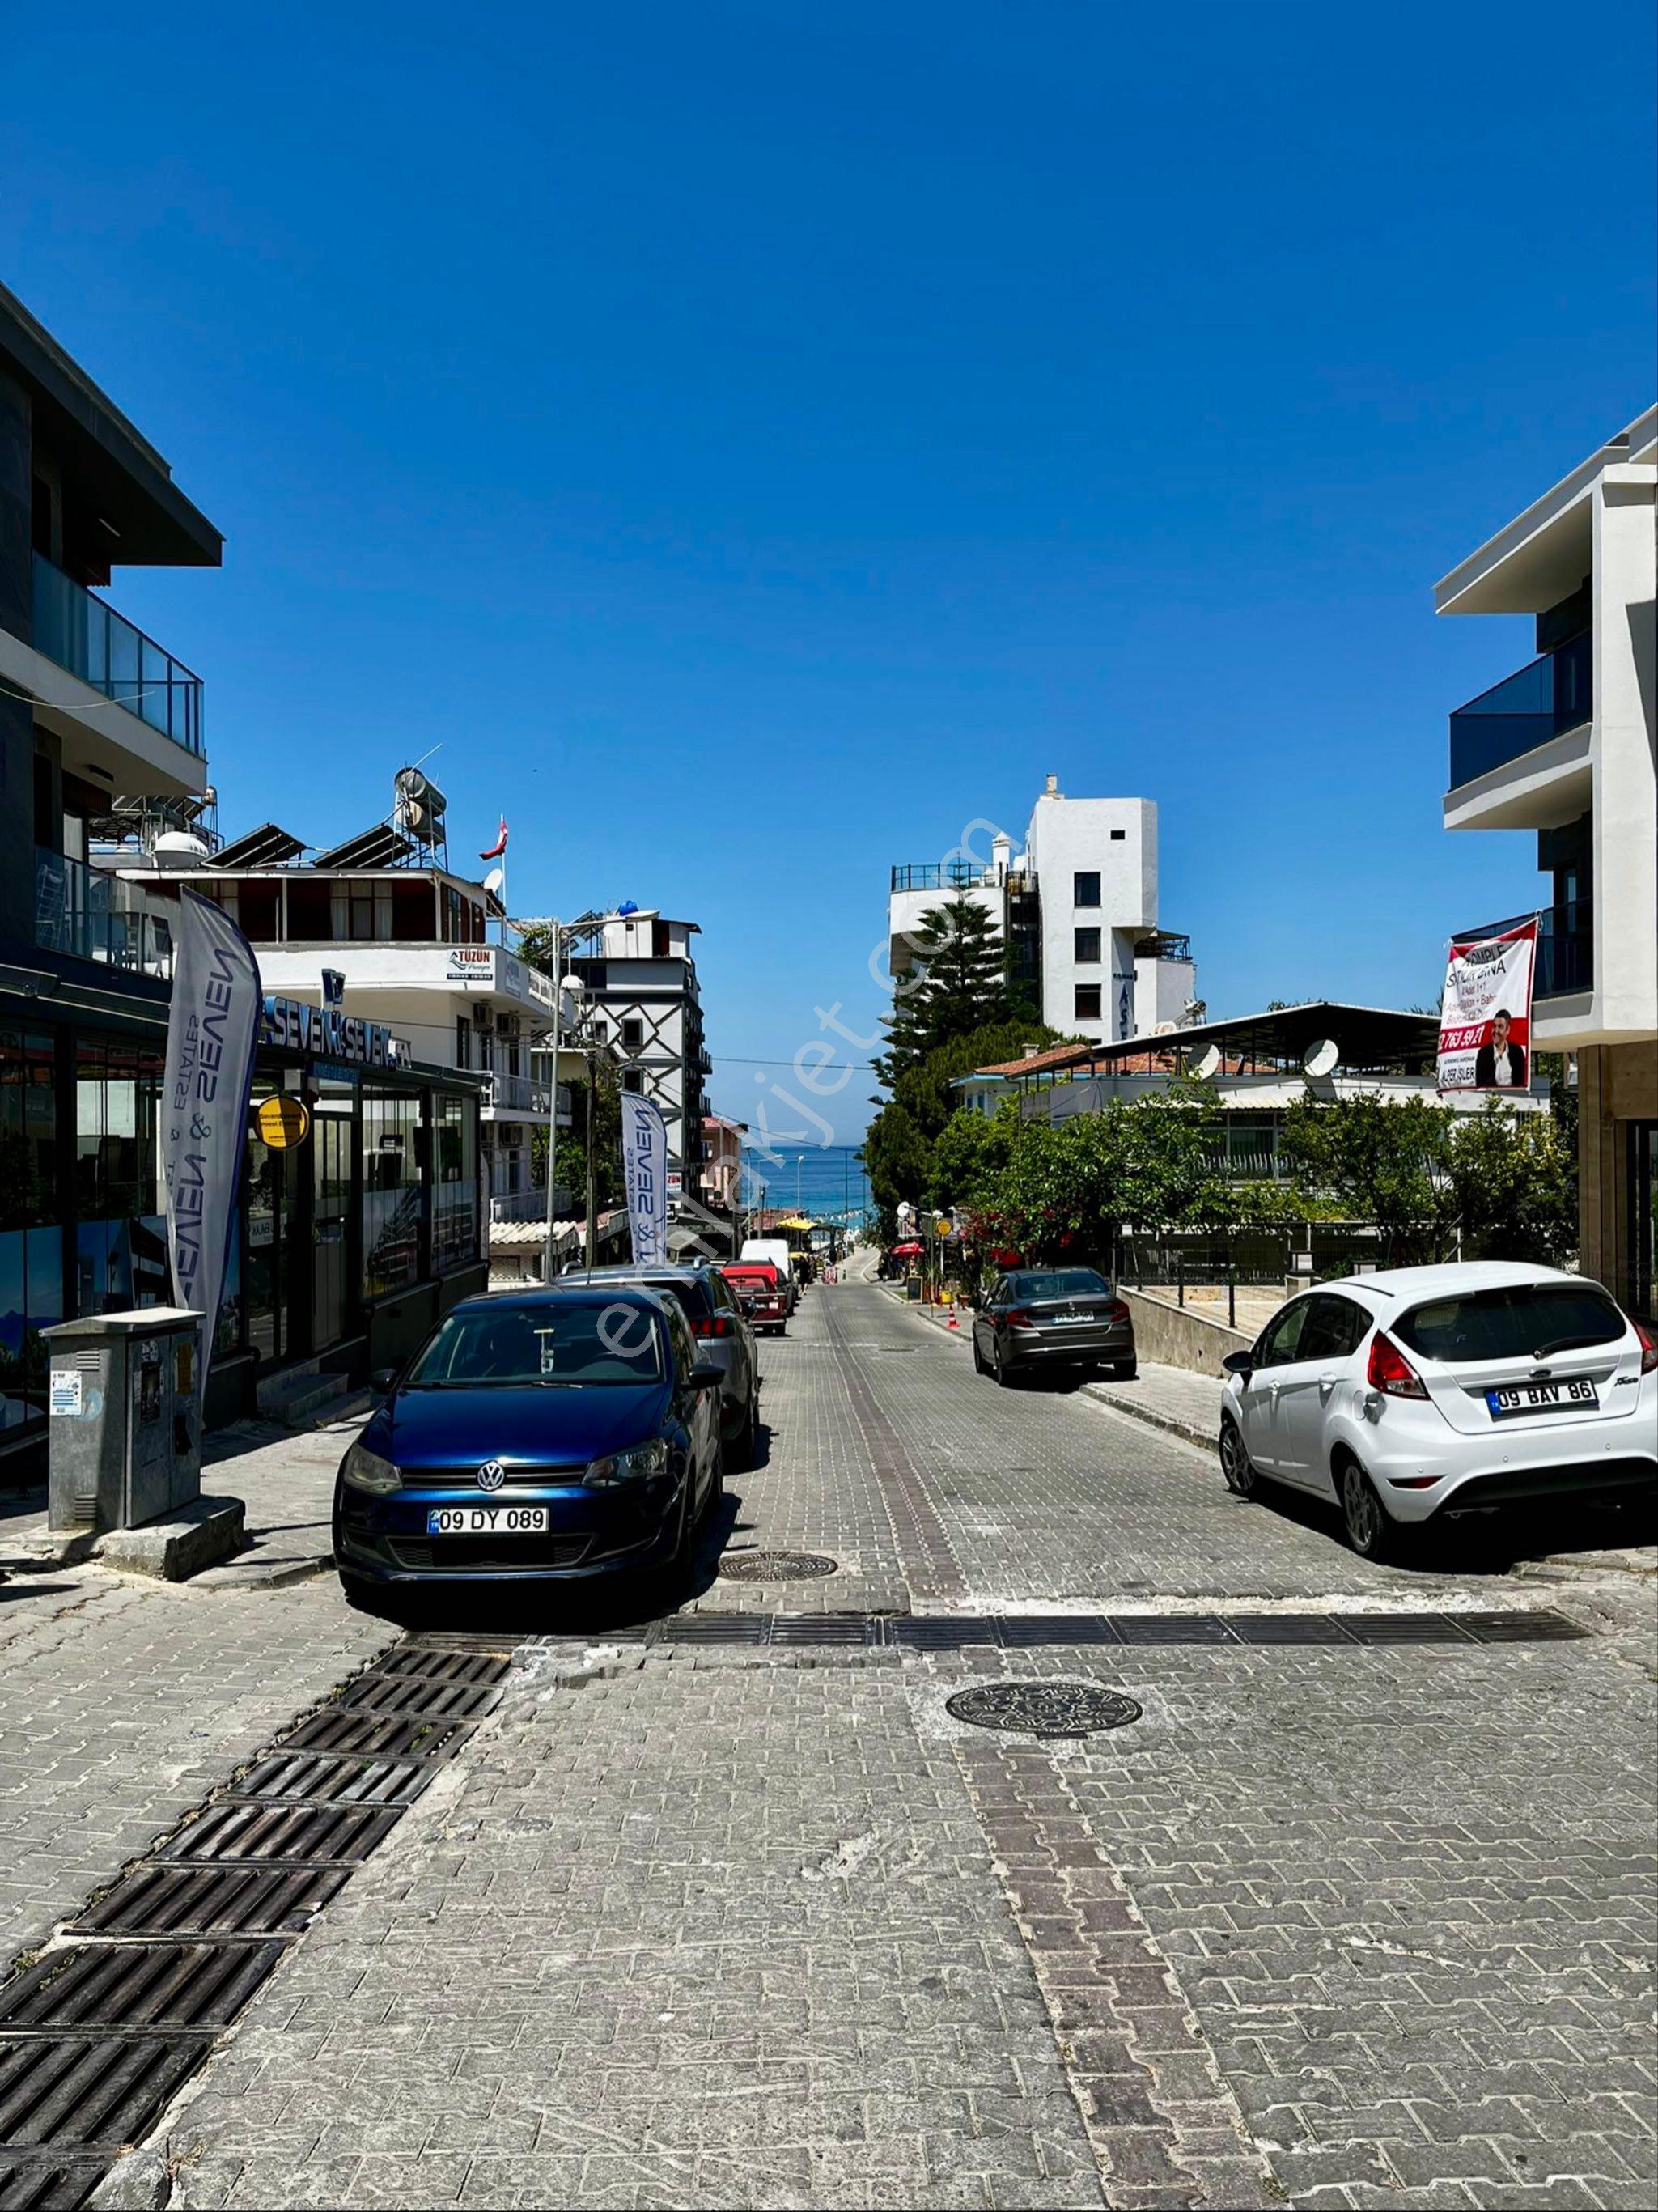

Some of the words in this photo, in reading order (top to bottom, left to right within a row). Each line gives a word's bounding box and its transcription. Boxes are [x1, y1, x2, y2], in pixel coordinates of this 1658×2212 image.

[459, 945, 490, 962] TÜZÜN
[668, 1174, 681, 1184] ZÜN
[1498, 1390, 1520, 1408] 09
[1527, 1385, 1561, 1405] BAV
[1568, 1382, 1592, 1400] 86
[440, 1510, 464, 1530] 09
[471, 1511, 501, 1530] DY
[507, 1510, 544, 1530] 089
